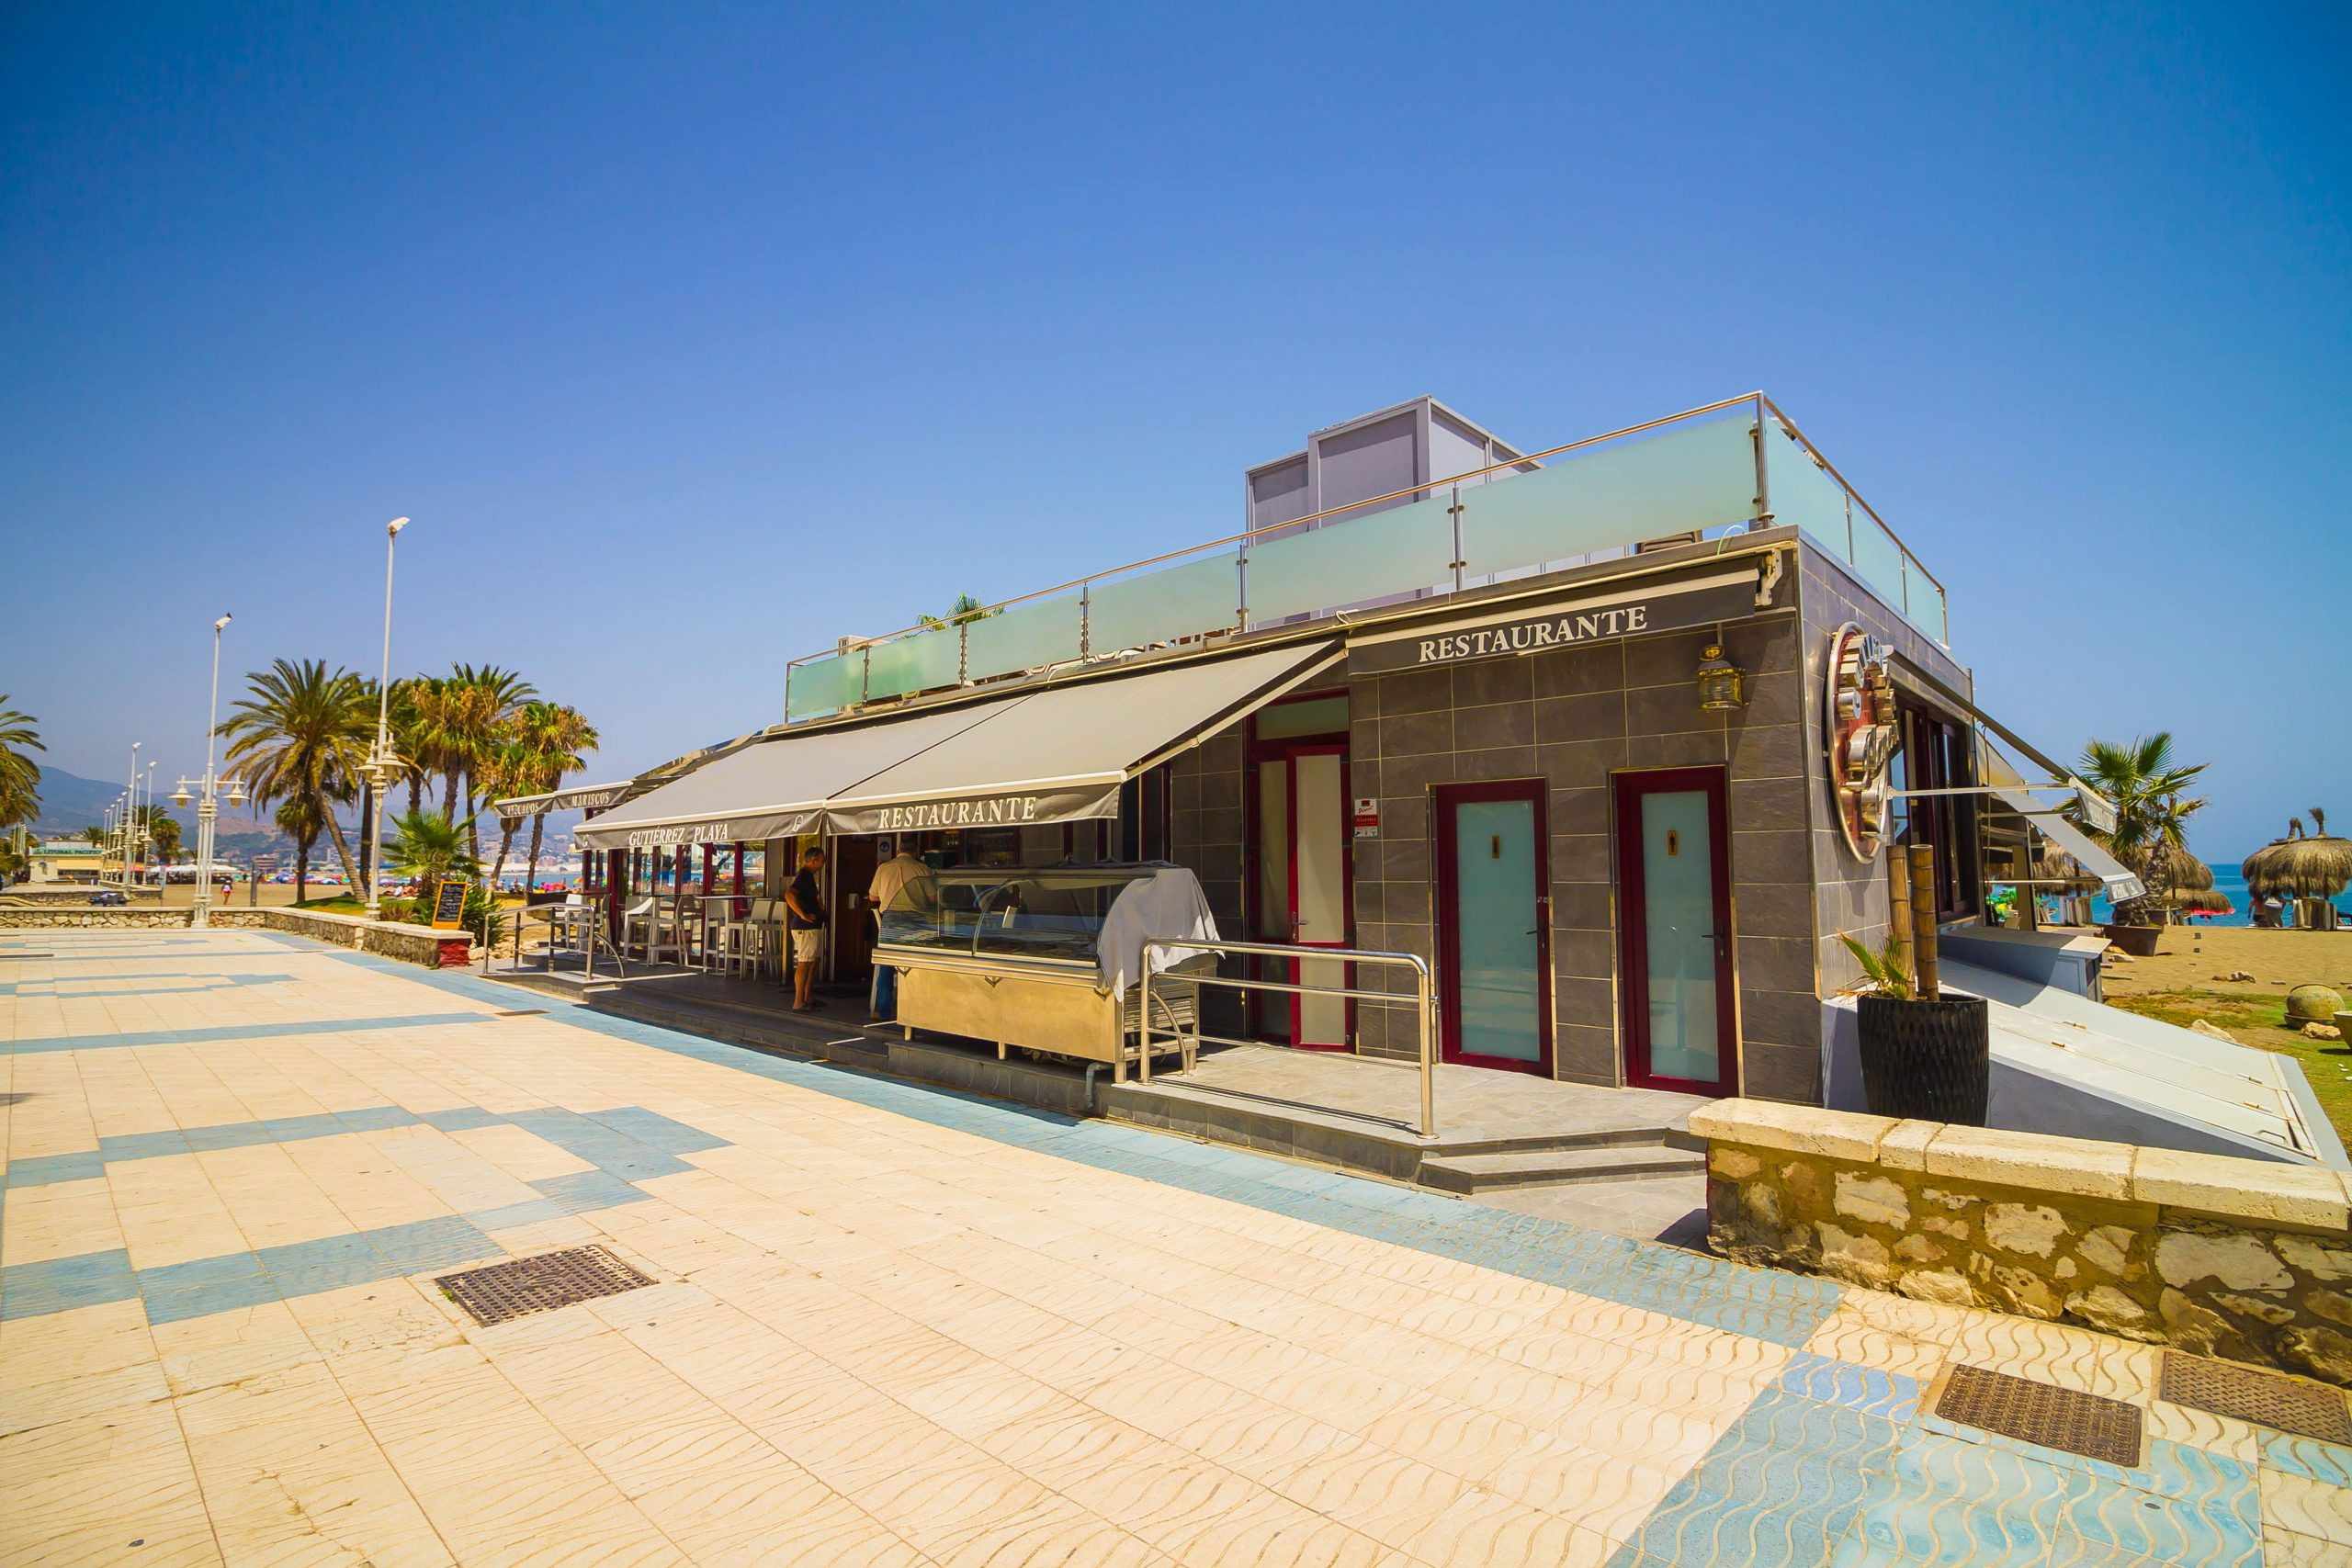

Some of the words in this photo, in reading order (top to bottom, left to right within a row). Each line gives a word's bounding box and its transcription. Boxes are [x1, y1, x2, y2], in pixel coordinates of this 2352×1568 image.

[1419, 605, 1647, 662] RESTAURANTE
[571, 792, 610, 807] MARISCOS
[878, 796, 1036, 829] RESTAURANTE
[628, 826, 685, 847] GUTIÉRREZ
[693, 823, 729, 842] PLAYA
